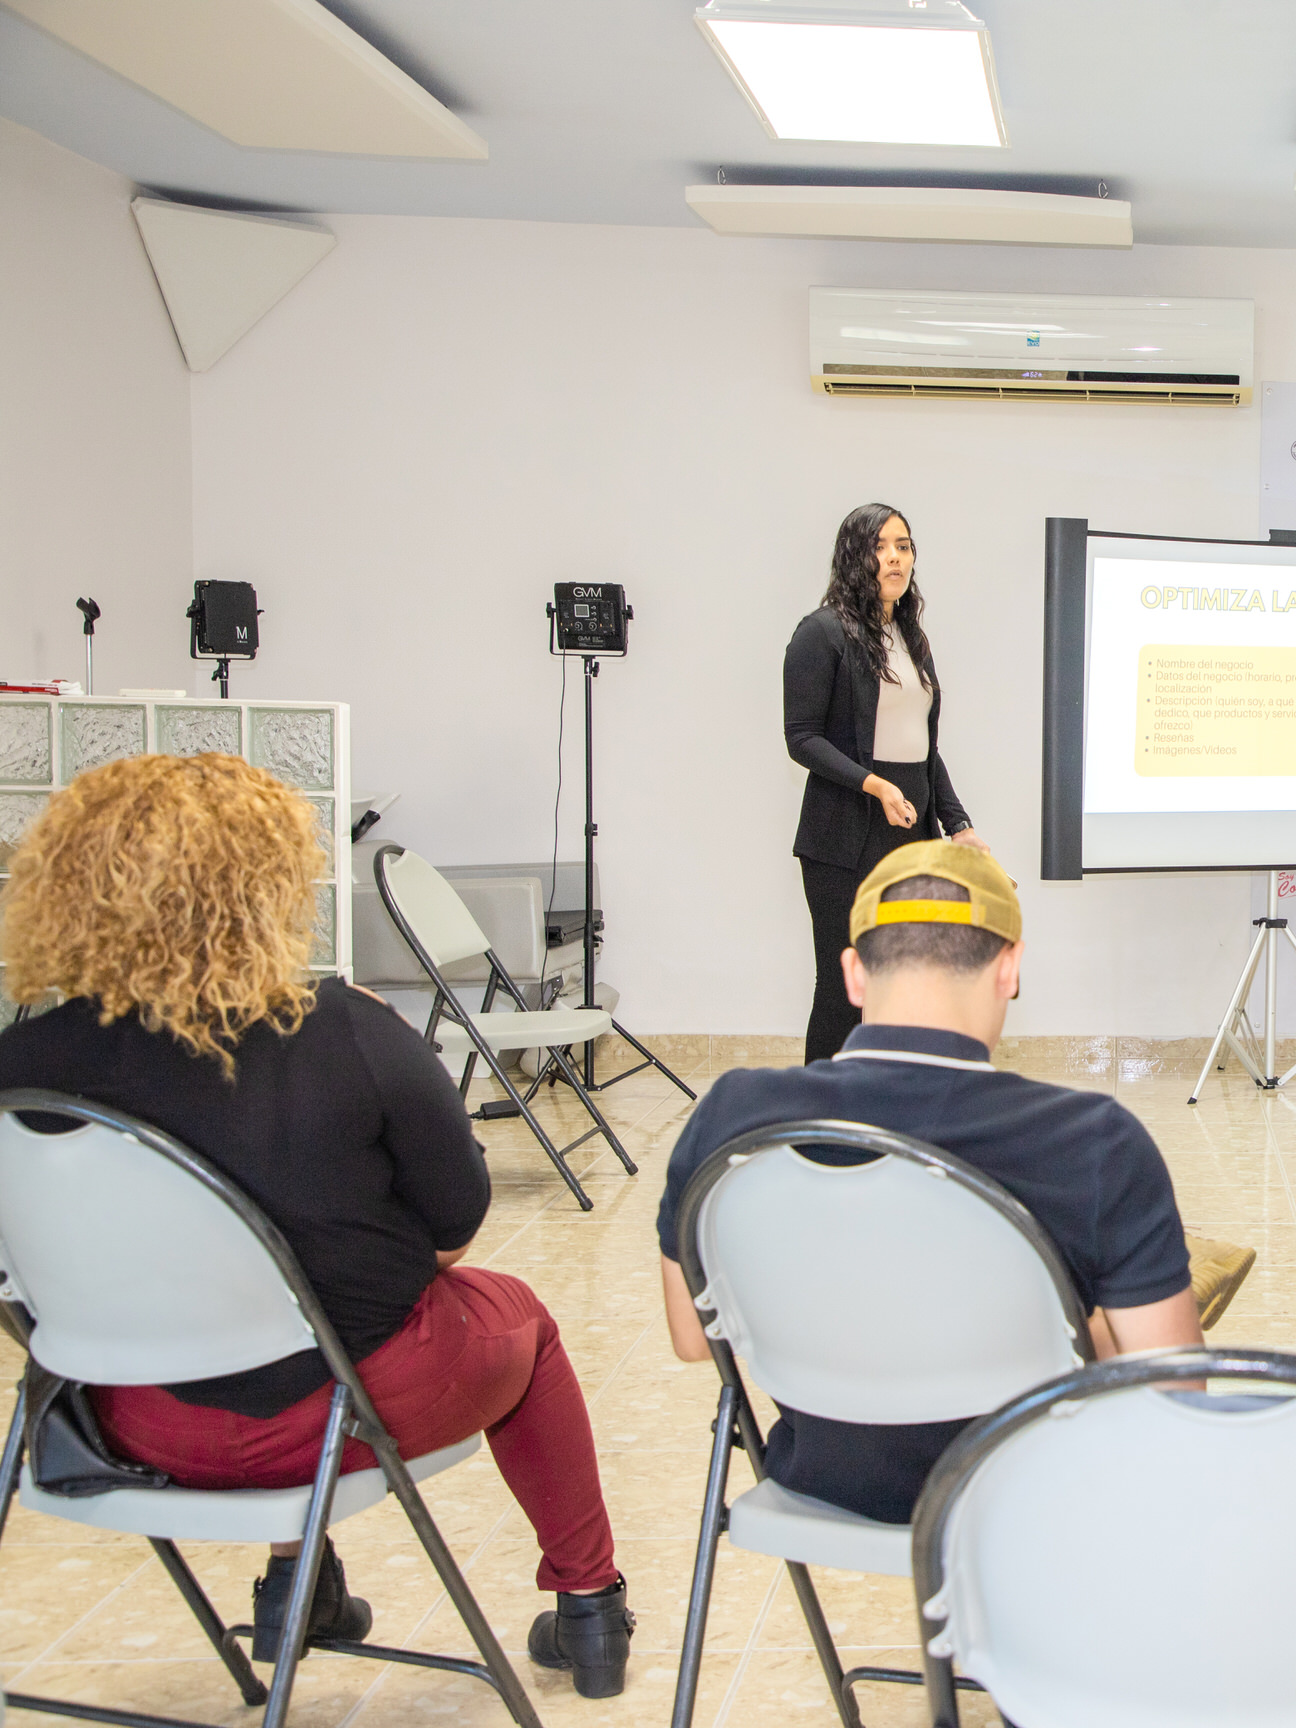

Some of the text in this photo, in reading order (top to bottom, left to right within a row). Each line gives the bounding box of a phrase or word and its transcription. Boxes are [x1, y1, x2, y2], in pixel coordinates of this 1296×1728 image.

[573, 587, 602, 598] GVM
[1140, 585, 1267, 612] OPTIMIZA
[236, 626, 248, 640] M
[1156, 659, 1254, 671] Nombre del negocio
[1156, 671, 1184, 681] Datos
[1186, 671, 1201, 681] del
[1203, 672, 1243, 683] negocio
[1155, 683, 1213, 694] localización
[1155, 696, 1213, 708] Descripción
[1214, 708, 1262, 720] productos
[1153, 732, 1194, 743] Reseñas
[1279, 872, 1295, 881] Soy
